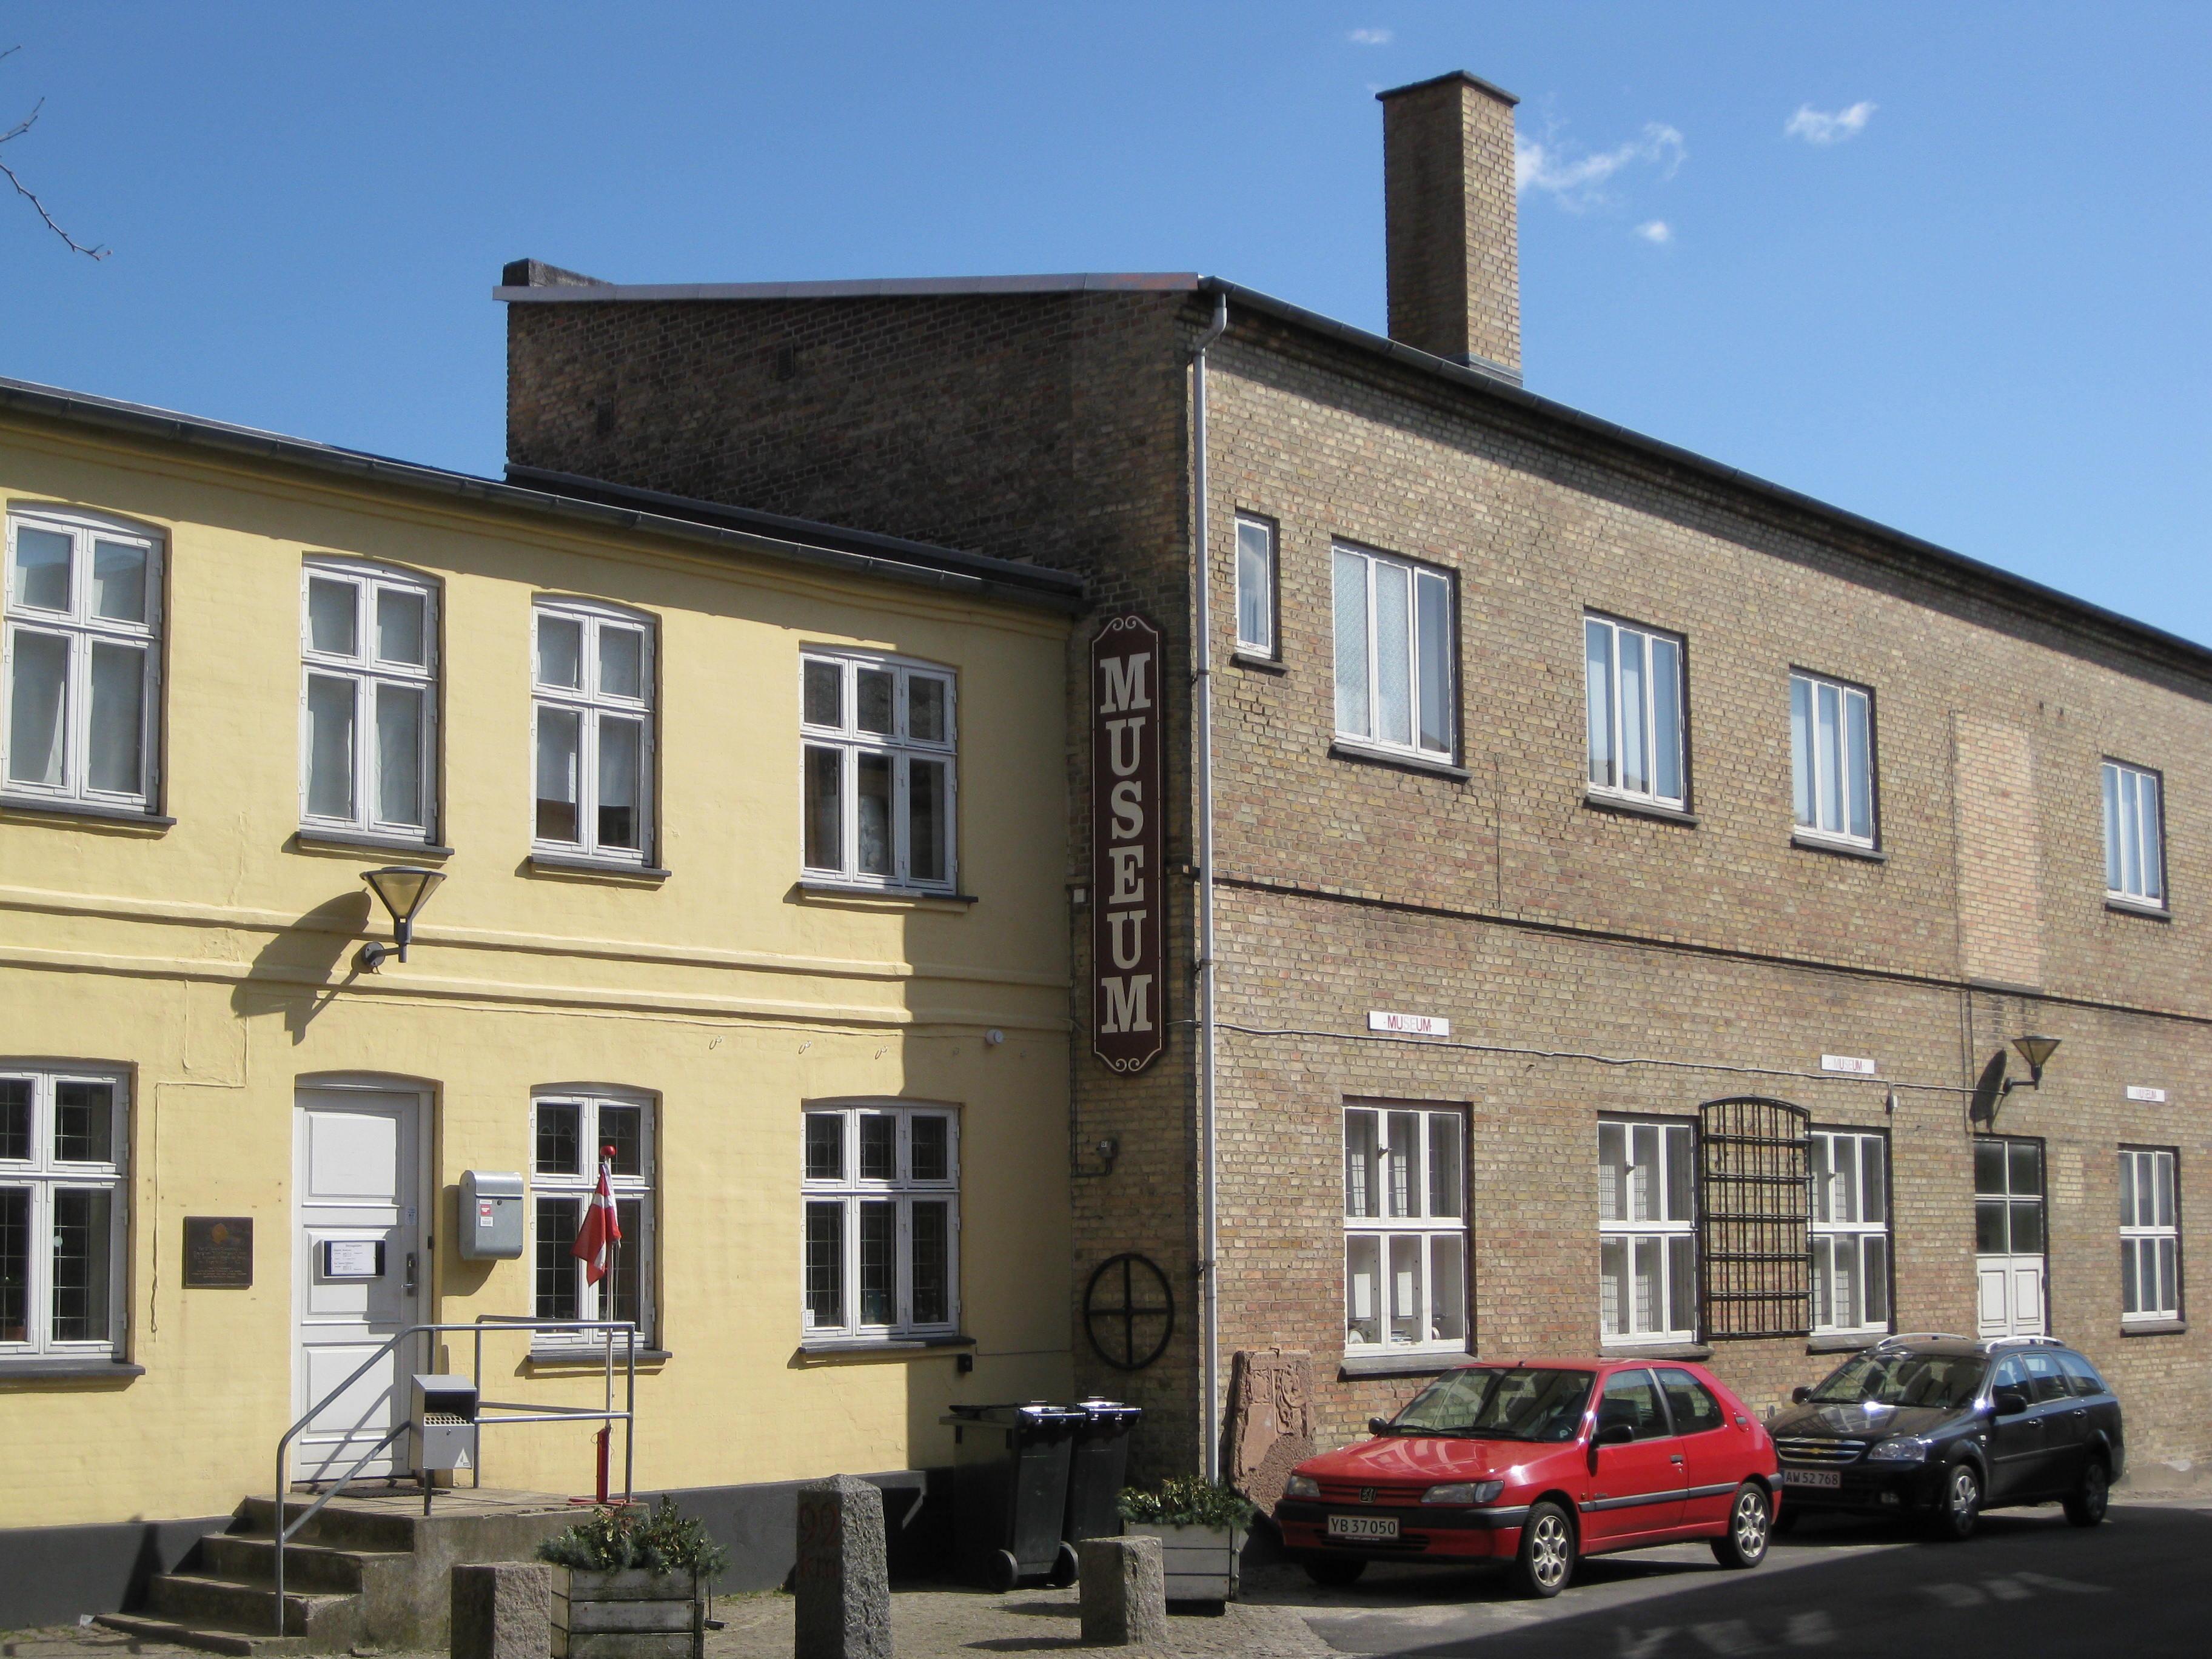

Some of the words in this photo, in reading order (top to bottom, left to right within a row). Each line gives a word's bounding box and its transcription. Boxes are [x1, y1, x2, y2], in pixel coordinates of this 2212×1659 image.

[1099, 651, 1153, 1034] MUSEUM
[1387, 1014, 1432, 1032] MUSEUM
[1785, 1473, 1800, 1483] AW
[1802, 1473, 1815, 1484] 52
[1818, 1473, 1838, 1485] 768
[799, 1503, 840, 1548] 92
